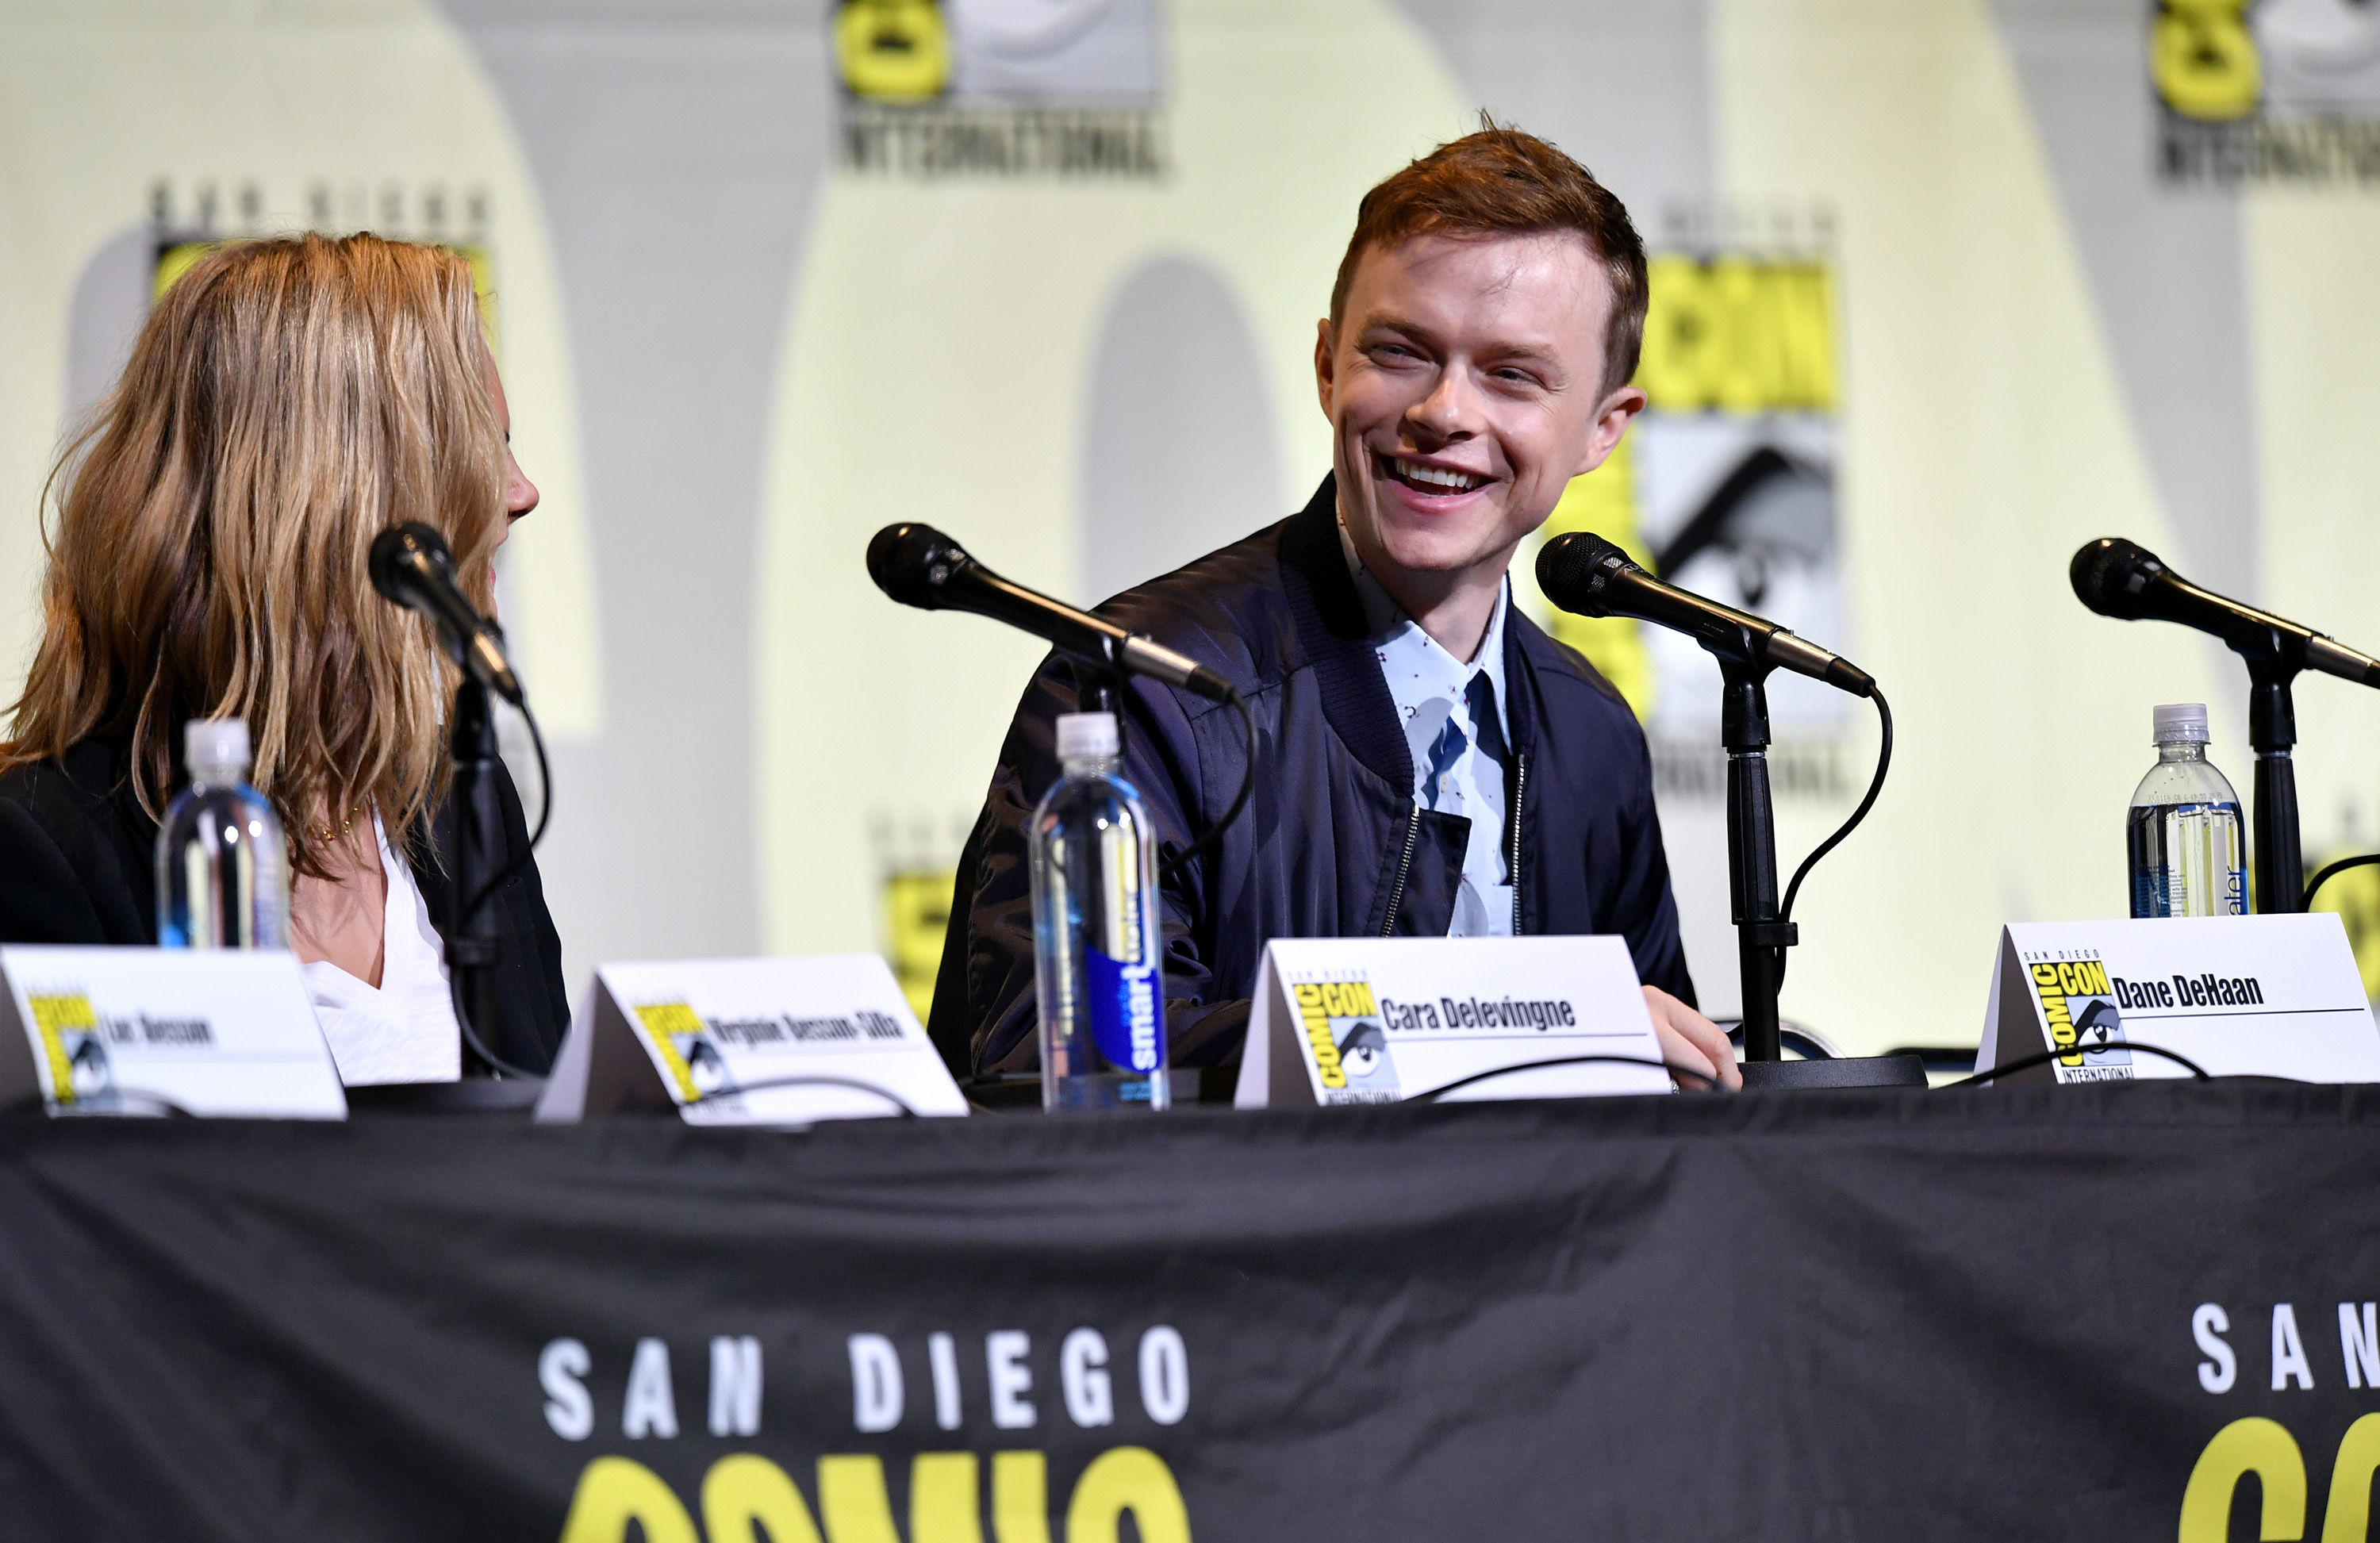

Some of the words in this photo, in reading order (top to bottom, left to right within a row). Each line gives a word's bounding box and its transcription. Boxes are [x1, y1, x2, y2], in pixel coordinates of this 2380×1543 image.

[2224, 866, 2241, 915] ater
[2025, 951, 2048, 961] SAN
[2059, 949, 2099, 960] DIEGO
[1322, 982, 1377, 1017] CON
[2057, 961, 2111, 996] CON
[2112, 977, 2175, 1009] Dane
[2172, 973, 2264, 1008] DeHaan
[1120, 965, 1157, 1070] smart
[1380, 998, 1441, 1031] Cara
[1440, 996, 1576, 1031] Delevingne
[2031, 963, 2083, 1066] COMIC
[1294, 984, 1347, 1088] COMIC
[2063, 1067, 2134, 1084] INTERNATIONAL
[2191, 1302, 2380, 1395] SAN
[538, 1336, 764, 1441] SAN
[847, 1325, 1190, 1433] DIEGO
